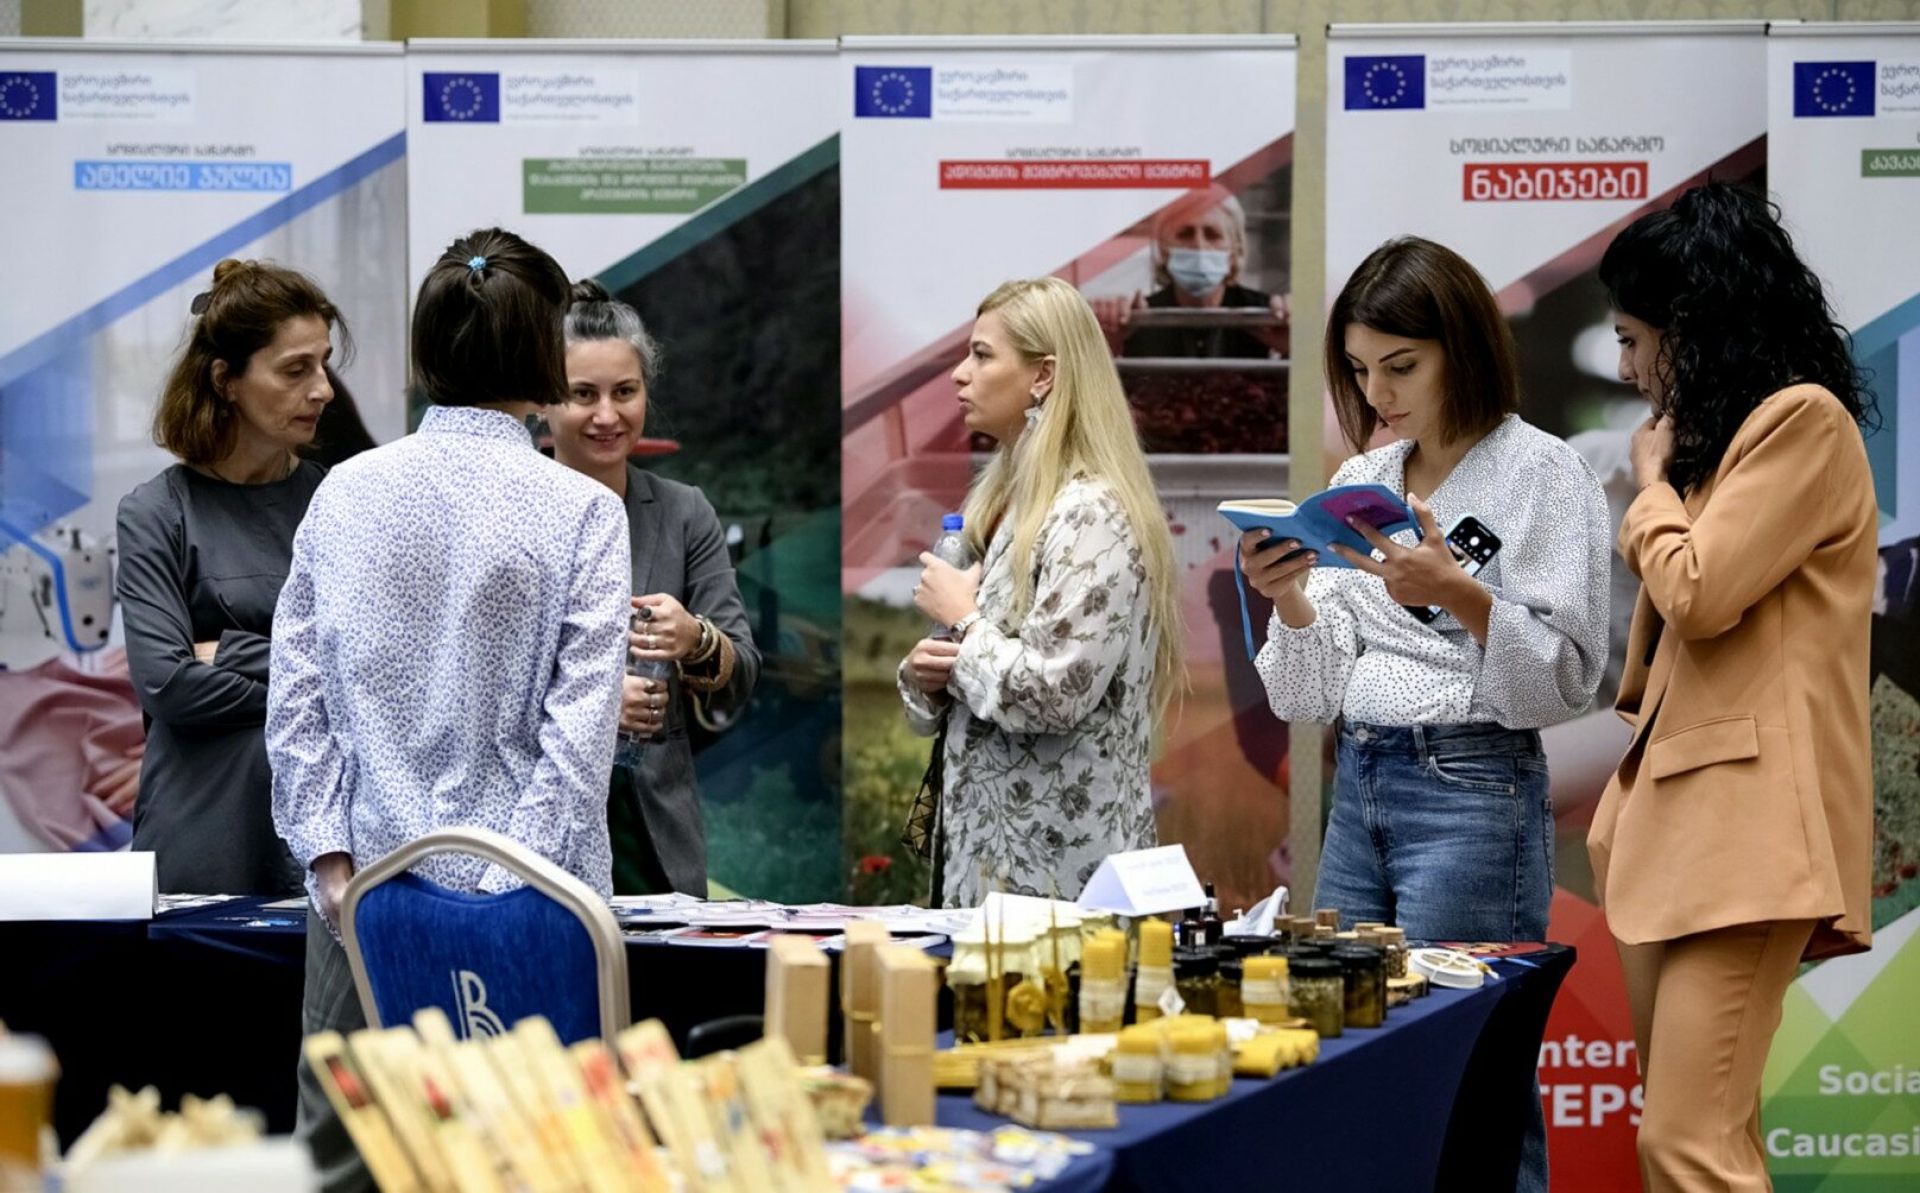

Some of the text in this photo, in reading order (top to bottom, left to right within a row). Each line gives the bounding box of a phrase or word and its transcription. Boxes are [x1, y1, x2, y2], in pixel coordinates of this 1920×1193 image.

[1450, 137, 1570, 154] სოციალური
[1470, 166, 1643, 200] ნაბიჯები
[1537, 1034, 1641, 1076] nter
[1766, 1125, 1920, 1158] Caucasi
